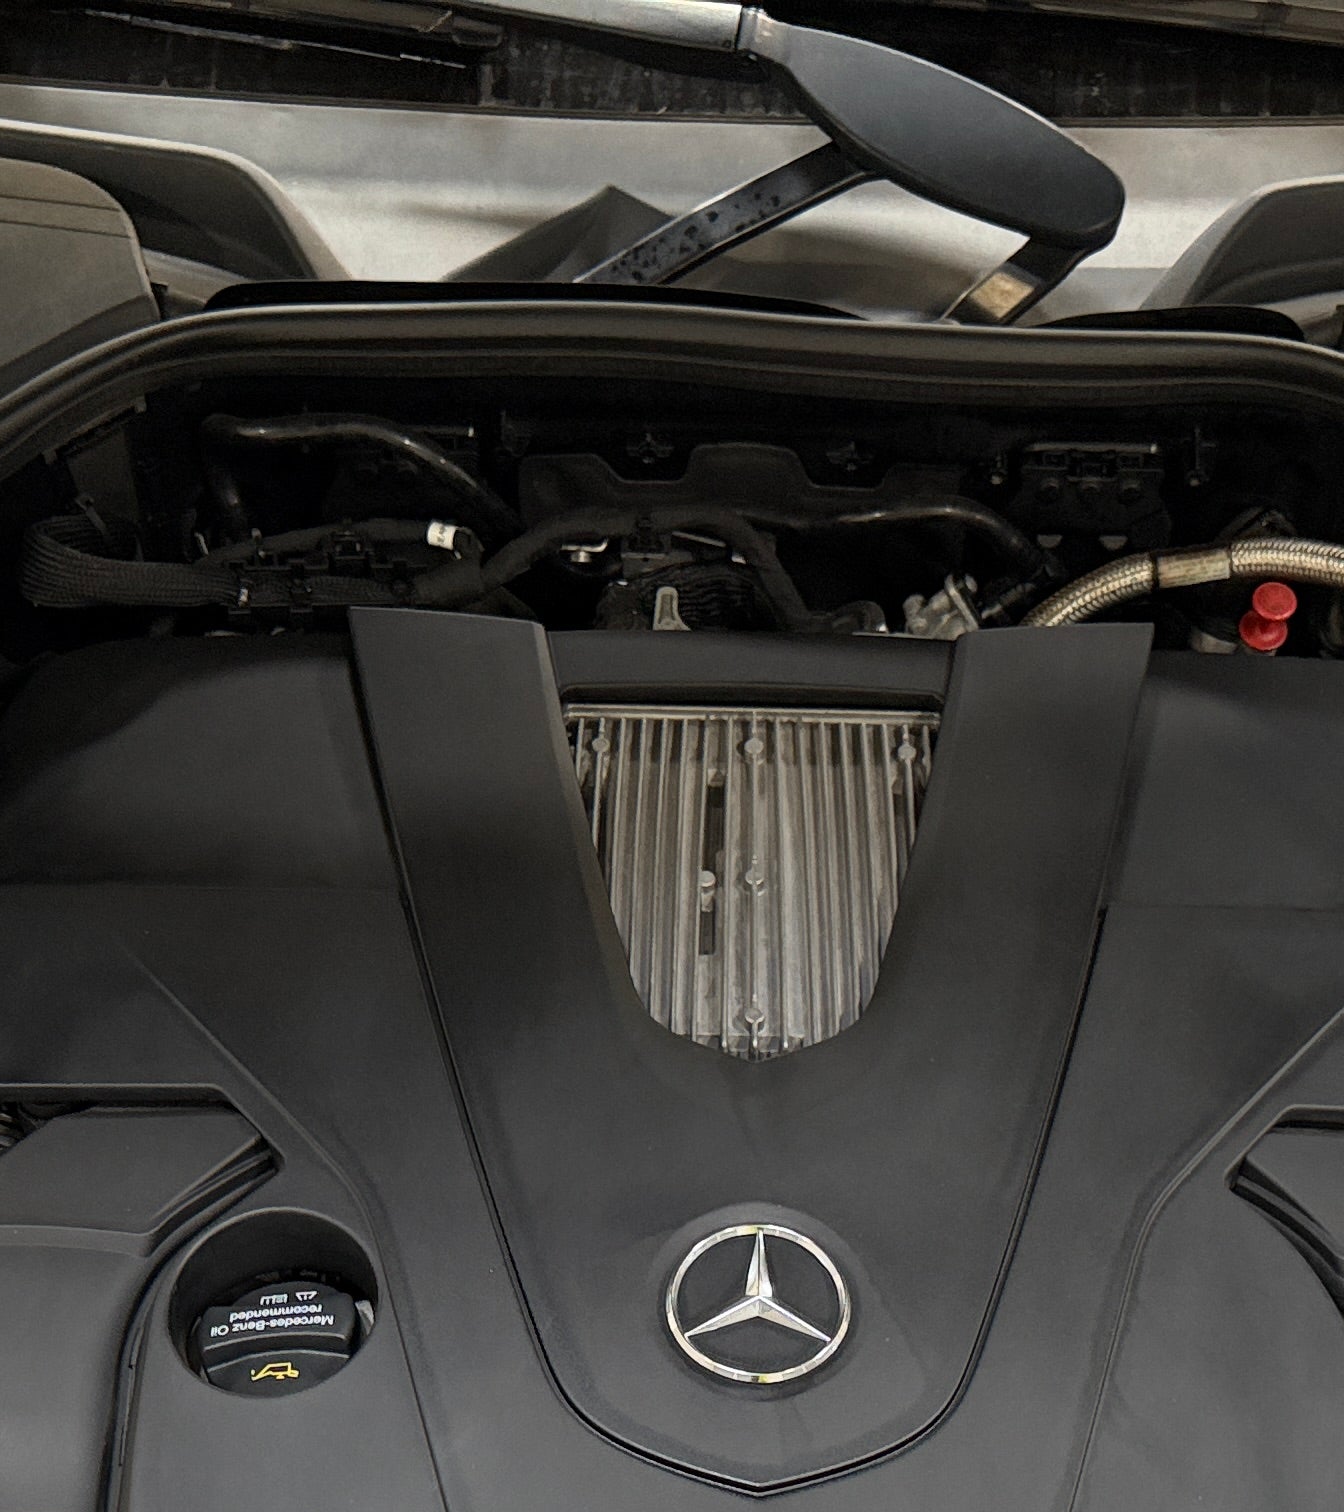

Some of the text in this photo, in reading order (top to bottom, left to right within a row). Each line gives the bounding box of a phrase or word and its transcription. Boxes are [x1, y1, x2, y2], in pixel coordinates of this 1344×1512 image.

[229, 1303, 323, 1323] recommended
[210, 1314, 334, 1337] Mercedes-Benz Oil
